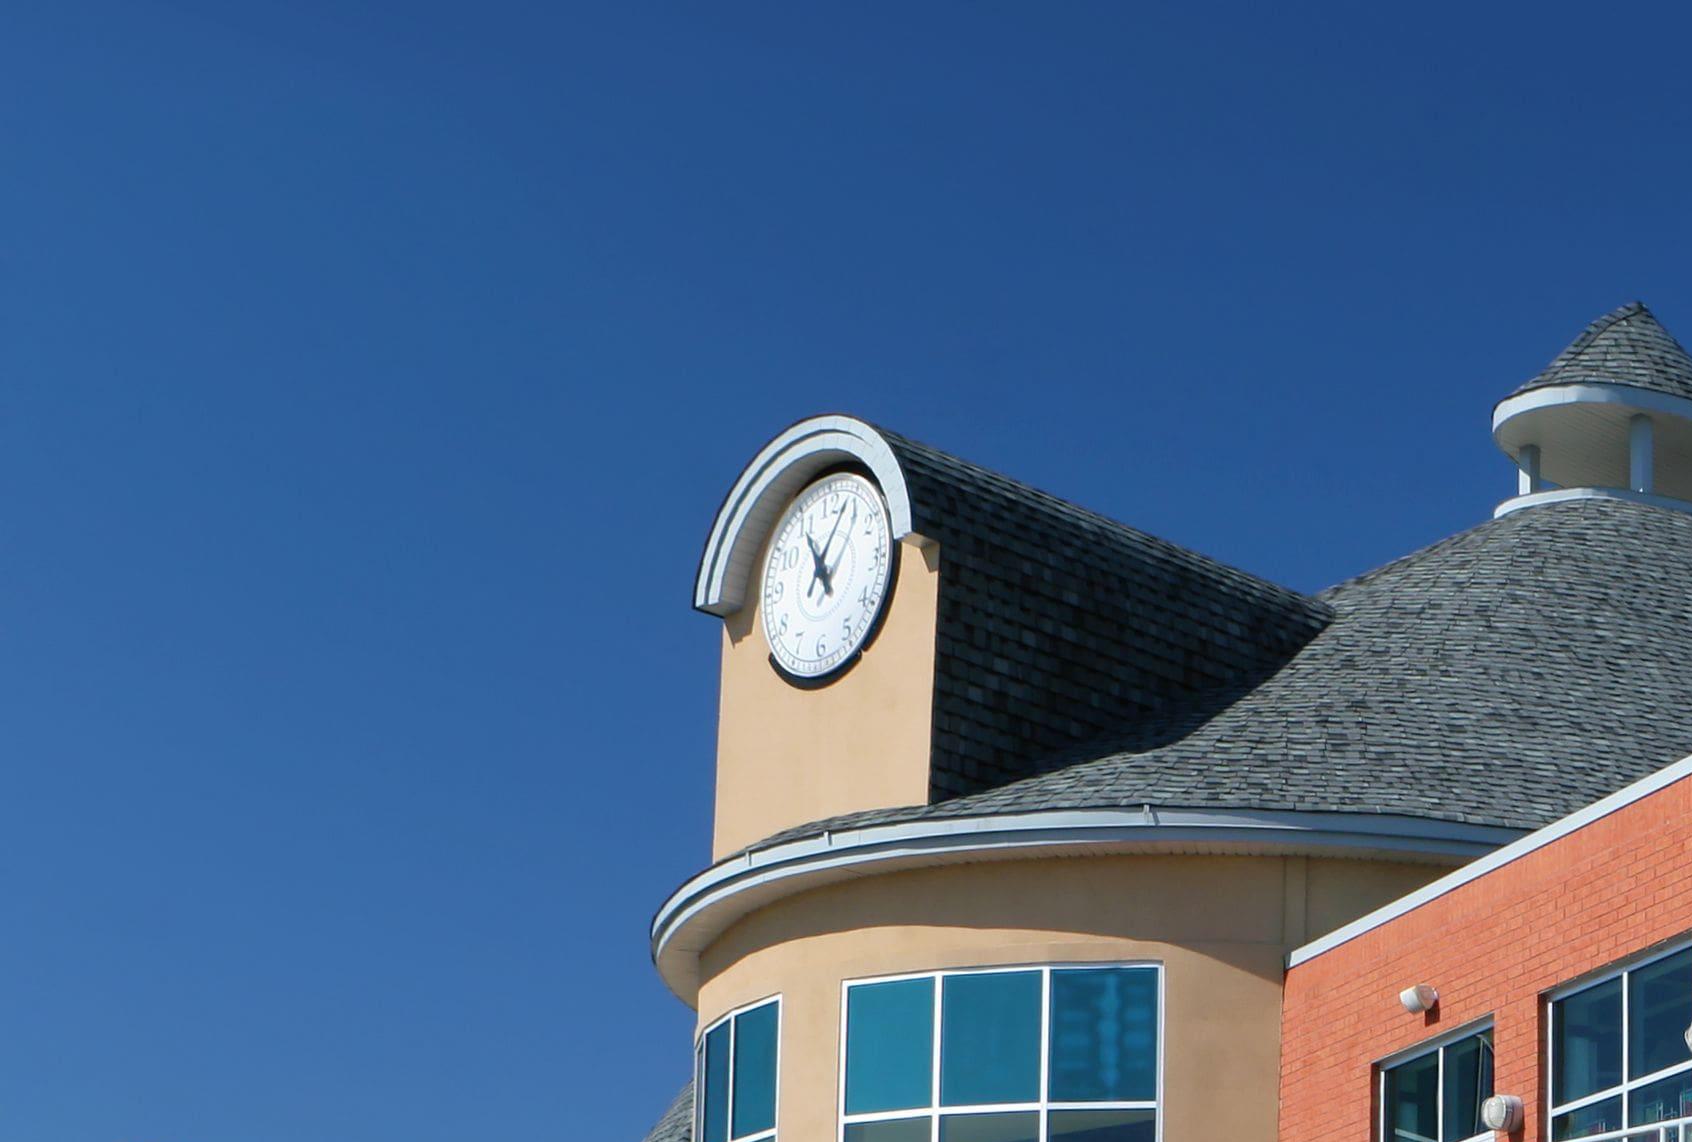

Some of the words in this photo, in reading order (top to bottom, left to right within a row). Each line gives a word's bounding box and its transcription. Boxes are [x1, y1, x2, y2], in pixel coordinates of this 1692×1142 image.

[821, 493, 839, 519] 12
[799, 514, 815, 538] 11
[864, 513, 874, 536] 2
[782, 546, 799, 571] 10
[868, 547, 879, 571] 3
[773, 580, 784, 604] 9
[857, 585, 868, 607] 4
[779, 612, 789, 636] 8
[841, 614, 852, 641] 5
[795, 631, 805, 655] 7
[816, 633, 827, 657] 6
